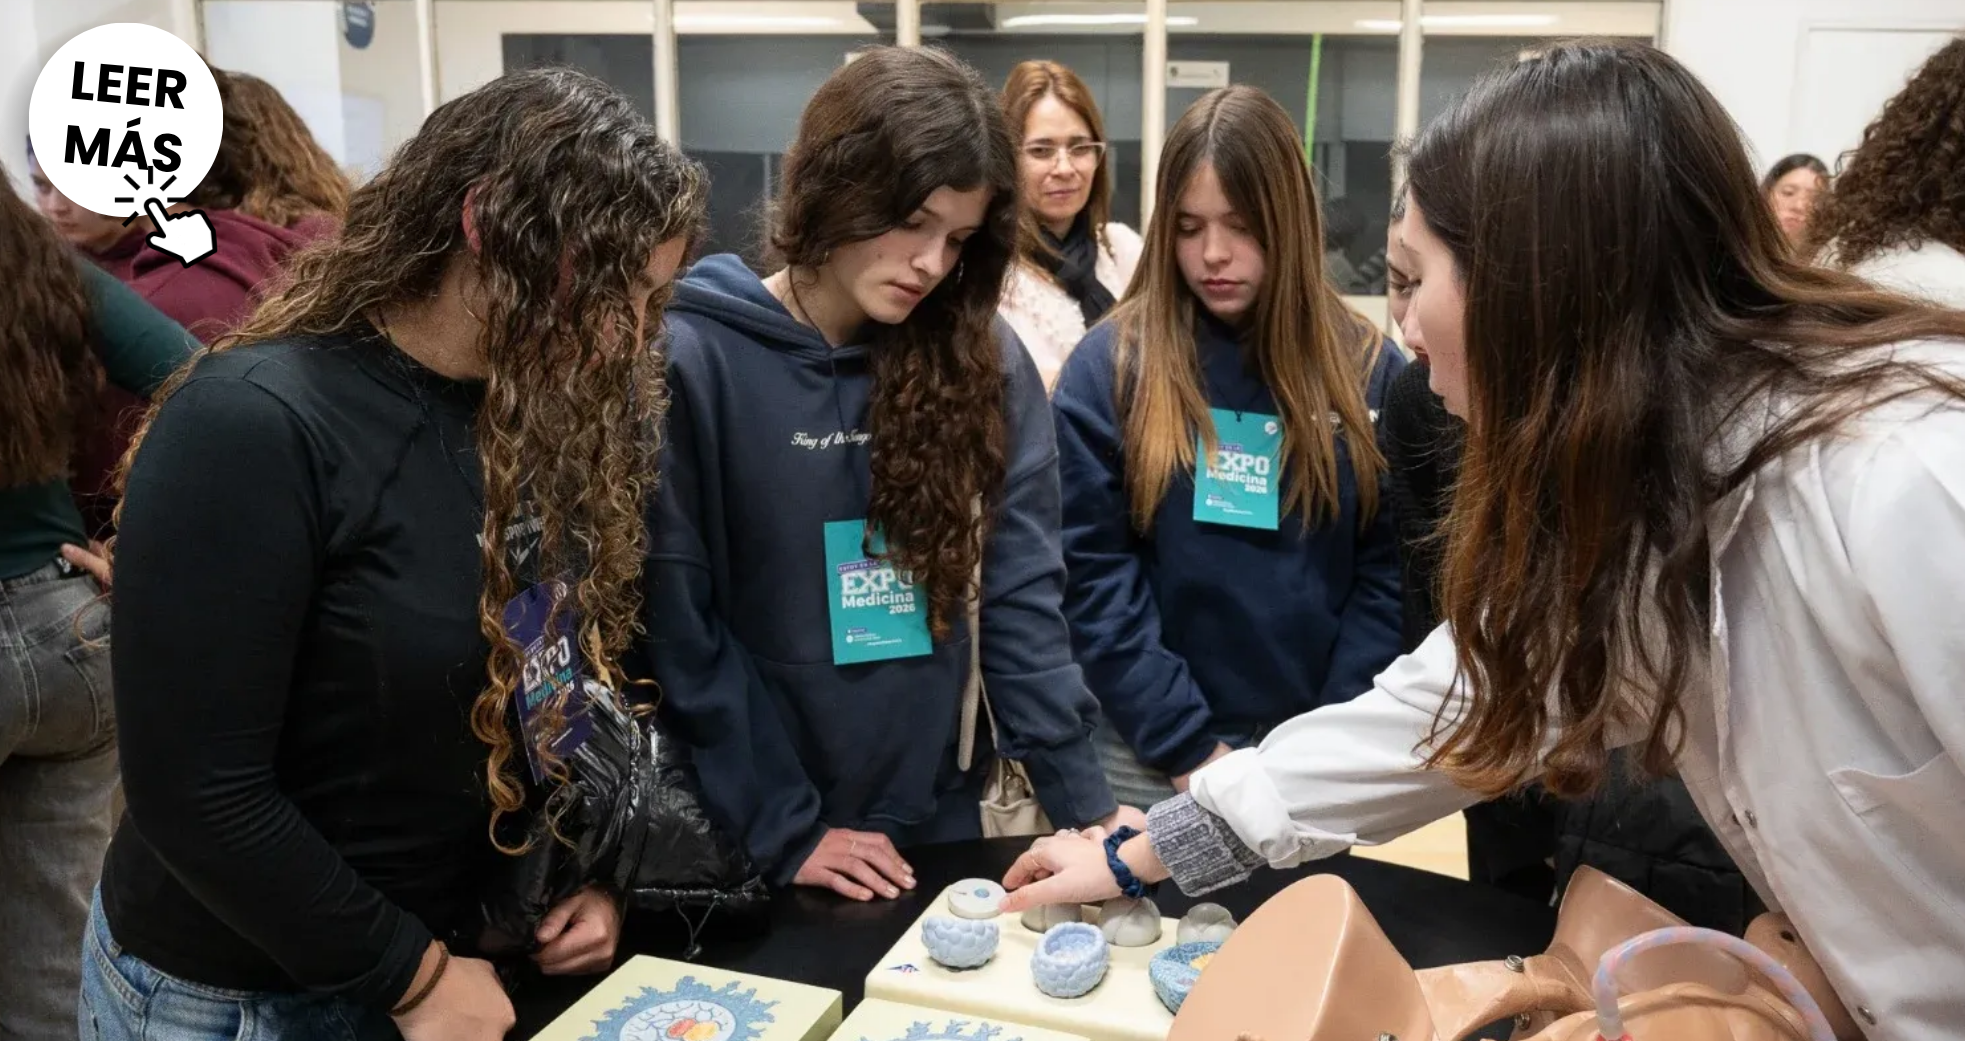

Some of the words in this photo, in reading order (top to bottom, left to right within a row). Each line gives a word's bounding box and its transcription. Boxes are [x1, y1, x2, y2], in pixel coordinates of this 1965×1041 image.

[842, 591, 915, 609] Medicina
[889, 603, 916, 615] 2026
[525, 667, 572, 710] Mediina
